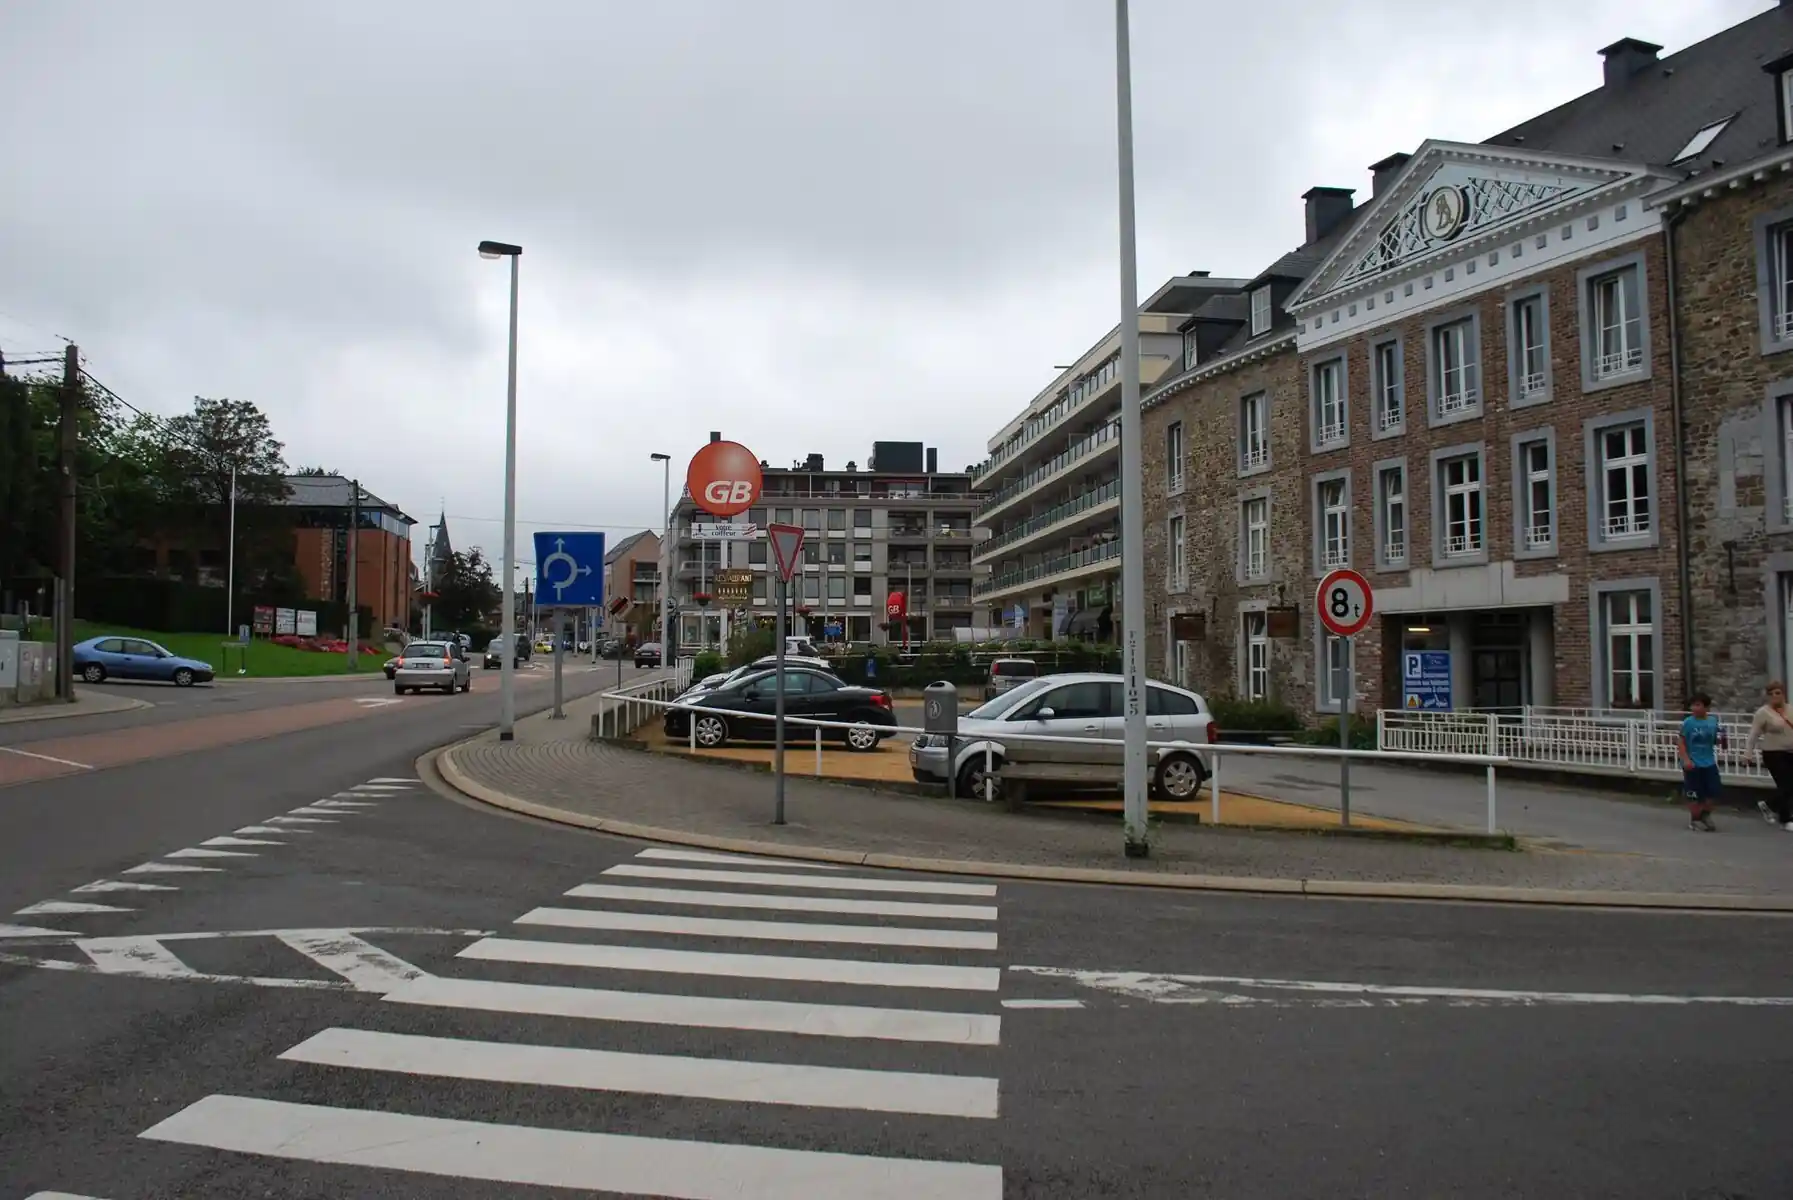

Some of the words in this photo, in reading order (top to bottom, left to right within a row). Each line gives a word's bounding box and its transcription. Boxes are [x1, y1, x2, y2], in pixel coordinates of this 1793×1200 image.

[705, 480, 752, 503] GB
[887, 604, 900, 614] GB
[1331, 587, 1349, 618] 8
[1353, 603, 1361, 618] t
[1408, 655, 1419, 676] P
